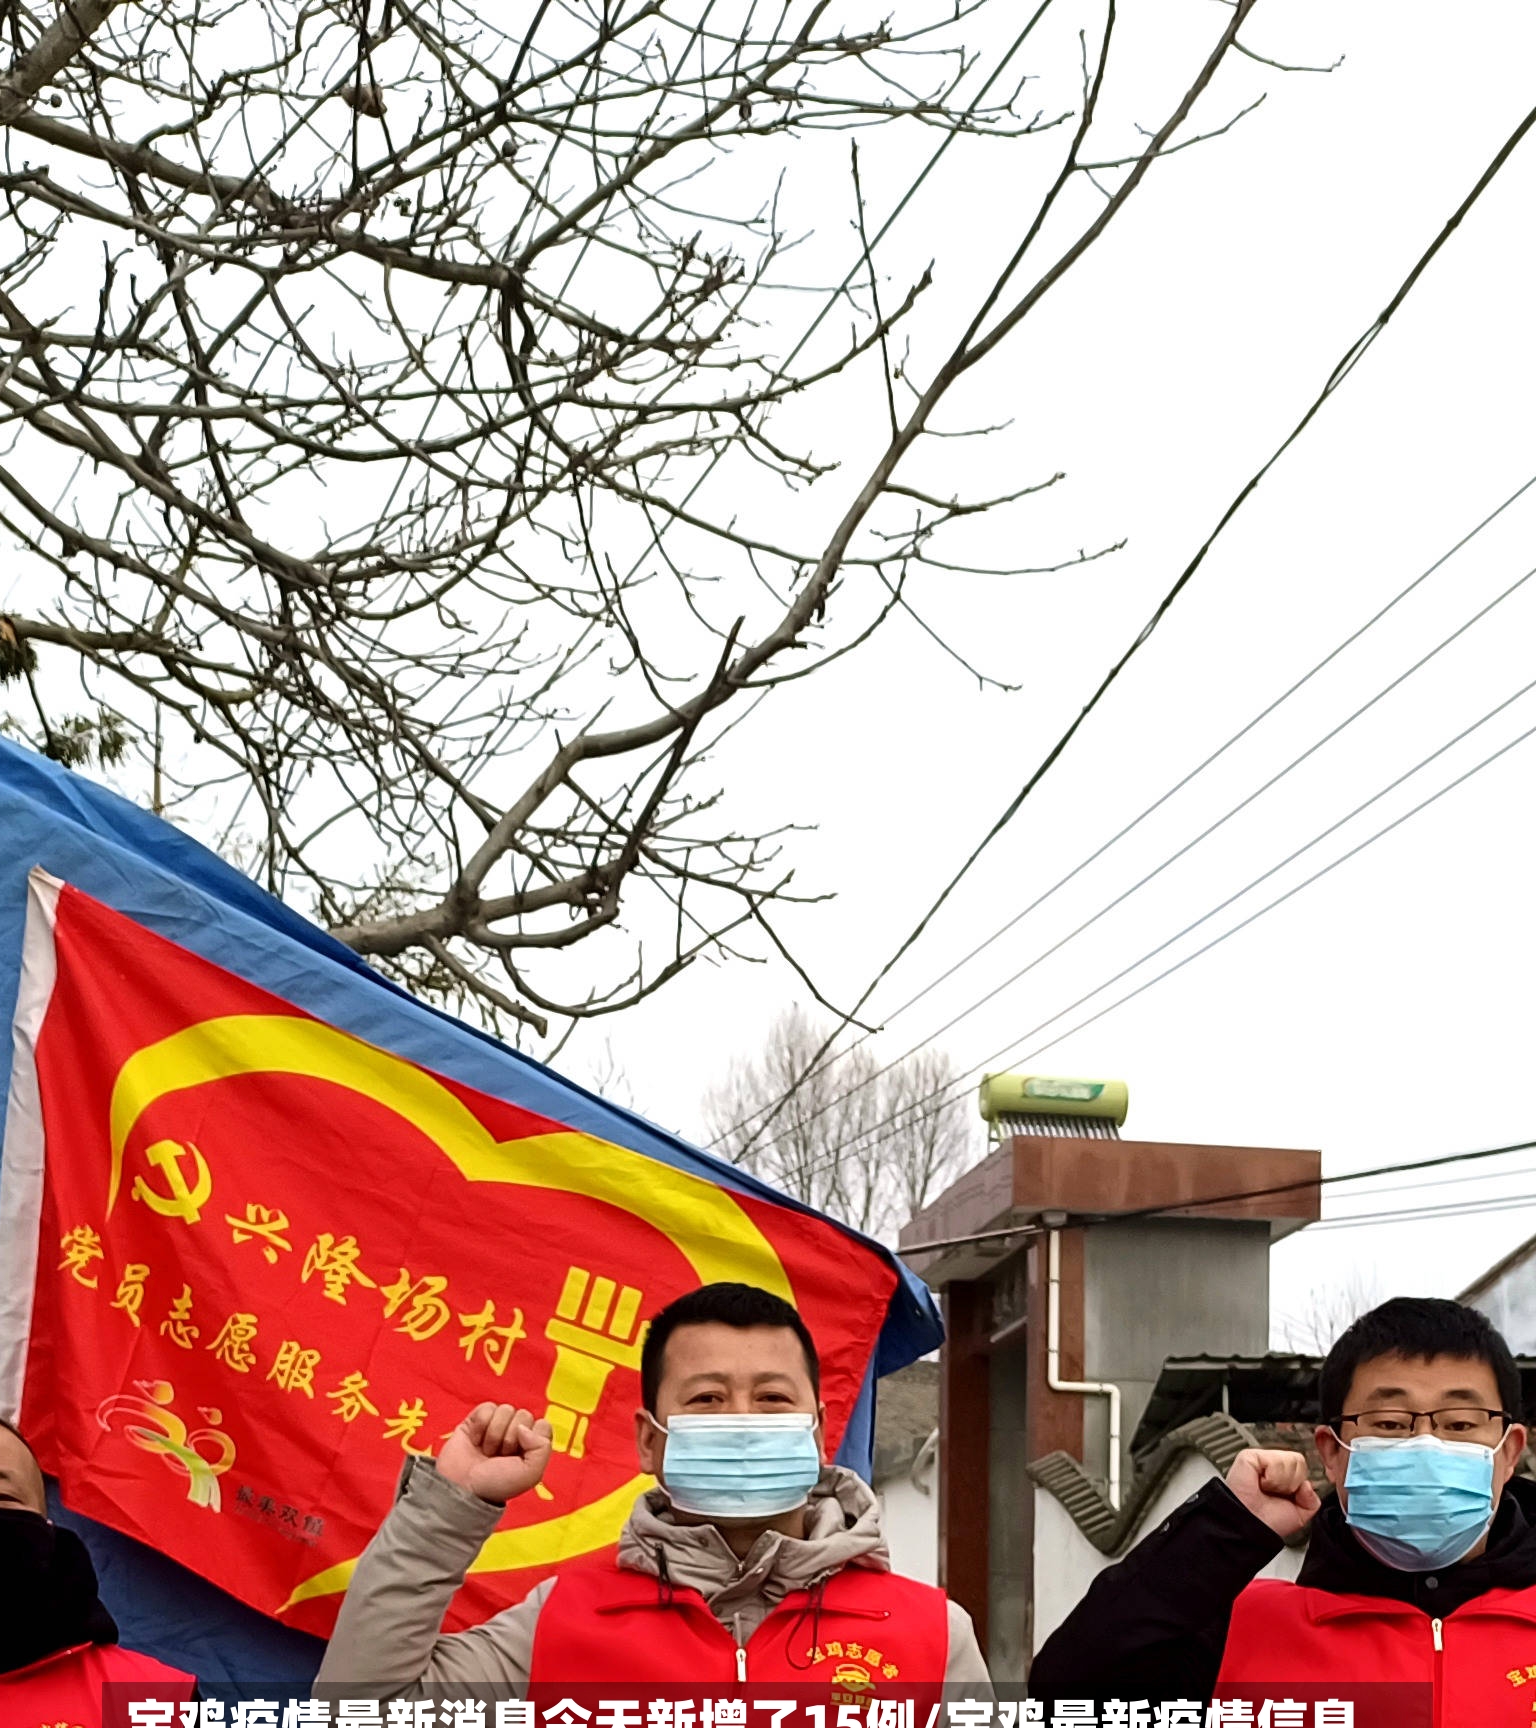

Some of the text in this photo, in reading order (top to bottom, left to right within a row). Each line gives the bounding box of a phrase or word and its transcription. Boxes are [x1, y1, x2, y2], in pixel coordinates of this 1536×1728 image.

[56, 1224, 555, 1500] 党员志愿服务先
[225, 1203, 526, 1376] 兴隆场村
